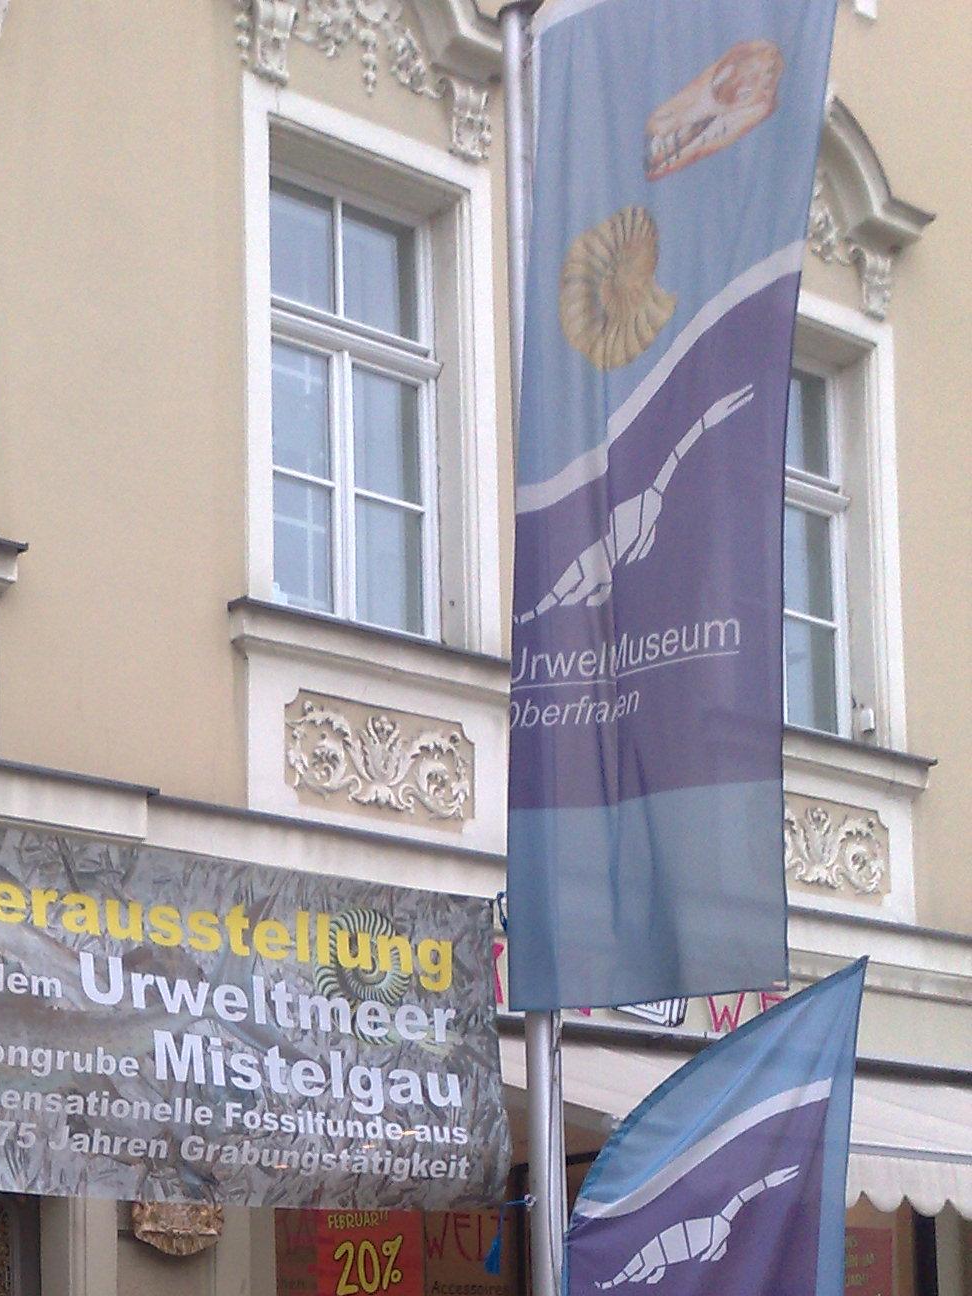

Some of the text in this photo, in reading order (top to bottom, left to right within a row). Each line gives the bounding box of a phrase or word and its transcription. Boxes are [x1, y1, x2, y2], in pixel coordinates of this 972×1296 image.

[79, 950, 457, 1044] Urweltmeer
[153, 1029, 463, 1116] Mistelgau
[48, 1124, 168, 1160] Jahren
[180, 1134, 471, 1184] Grabungstätigkeit
[225, 1101, 403, 1142] Fossilfunde
[415, 1124, 469, 1145] aus
[334, 1234, 404, 1296] 20%
